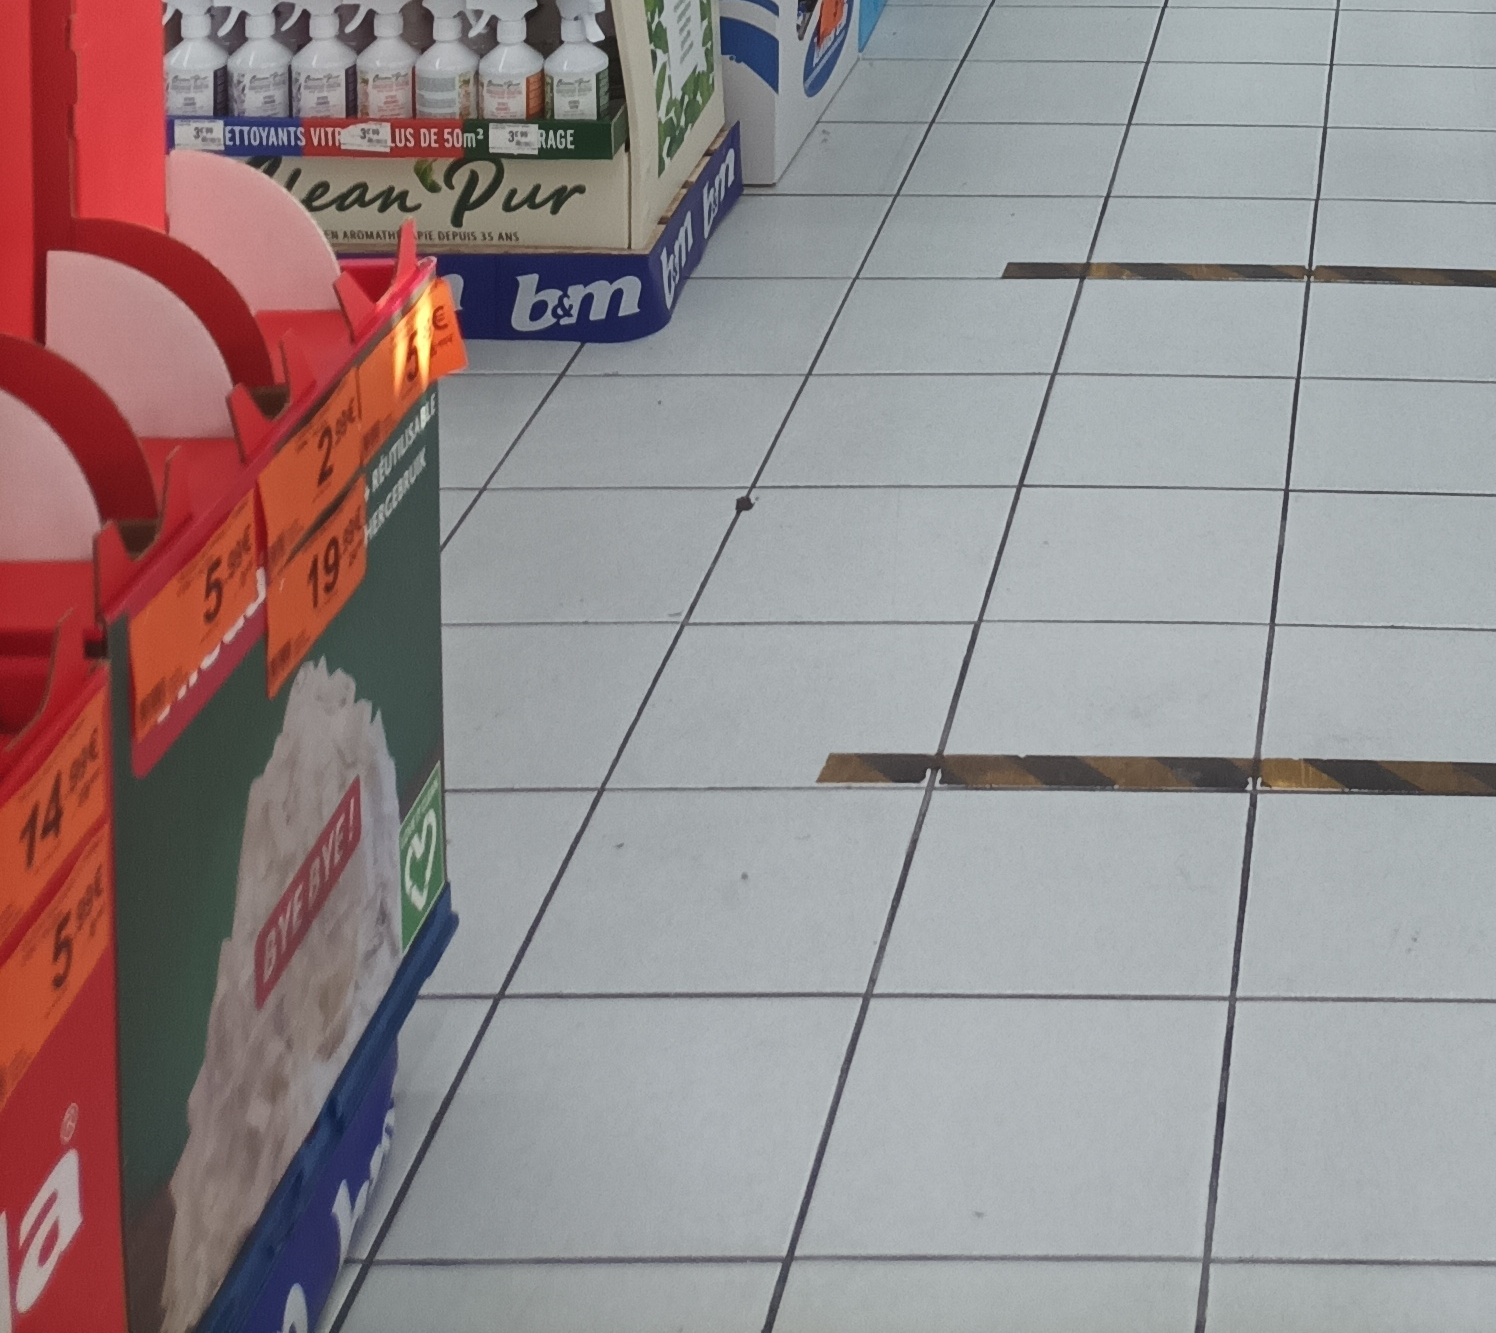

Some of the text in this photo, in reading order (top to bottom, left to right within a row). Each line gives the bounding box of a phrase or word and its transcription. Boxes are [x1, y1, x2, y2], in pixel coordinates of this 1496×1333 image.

[419, 129, 439, 148] DE
[443, 156, 587, 228] Pur
[438, 231, 520, 242] DEPUIS 35 ANS
[510, 272, 642, 333] b&m
[371, 393, 437, 491] RÉUTILISABLE
[263, 814, 347, 981] BYE BYE
